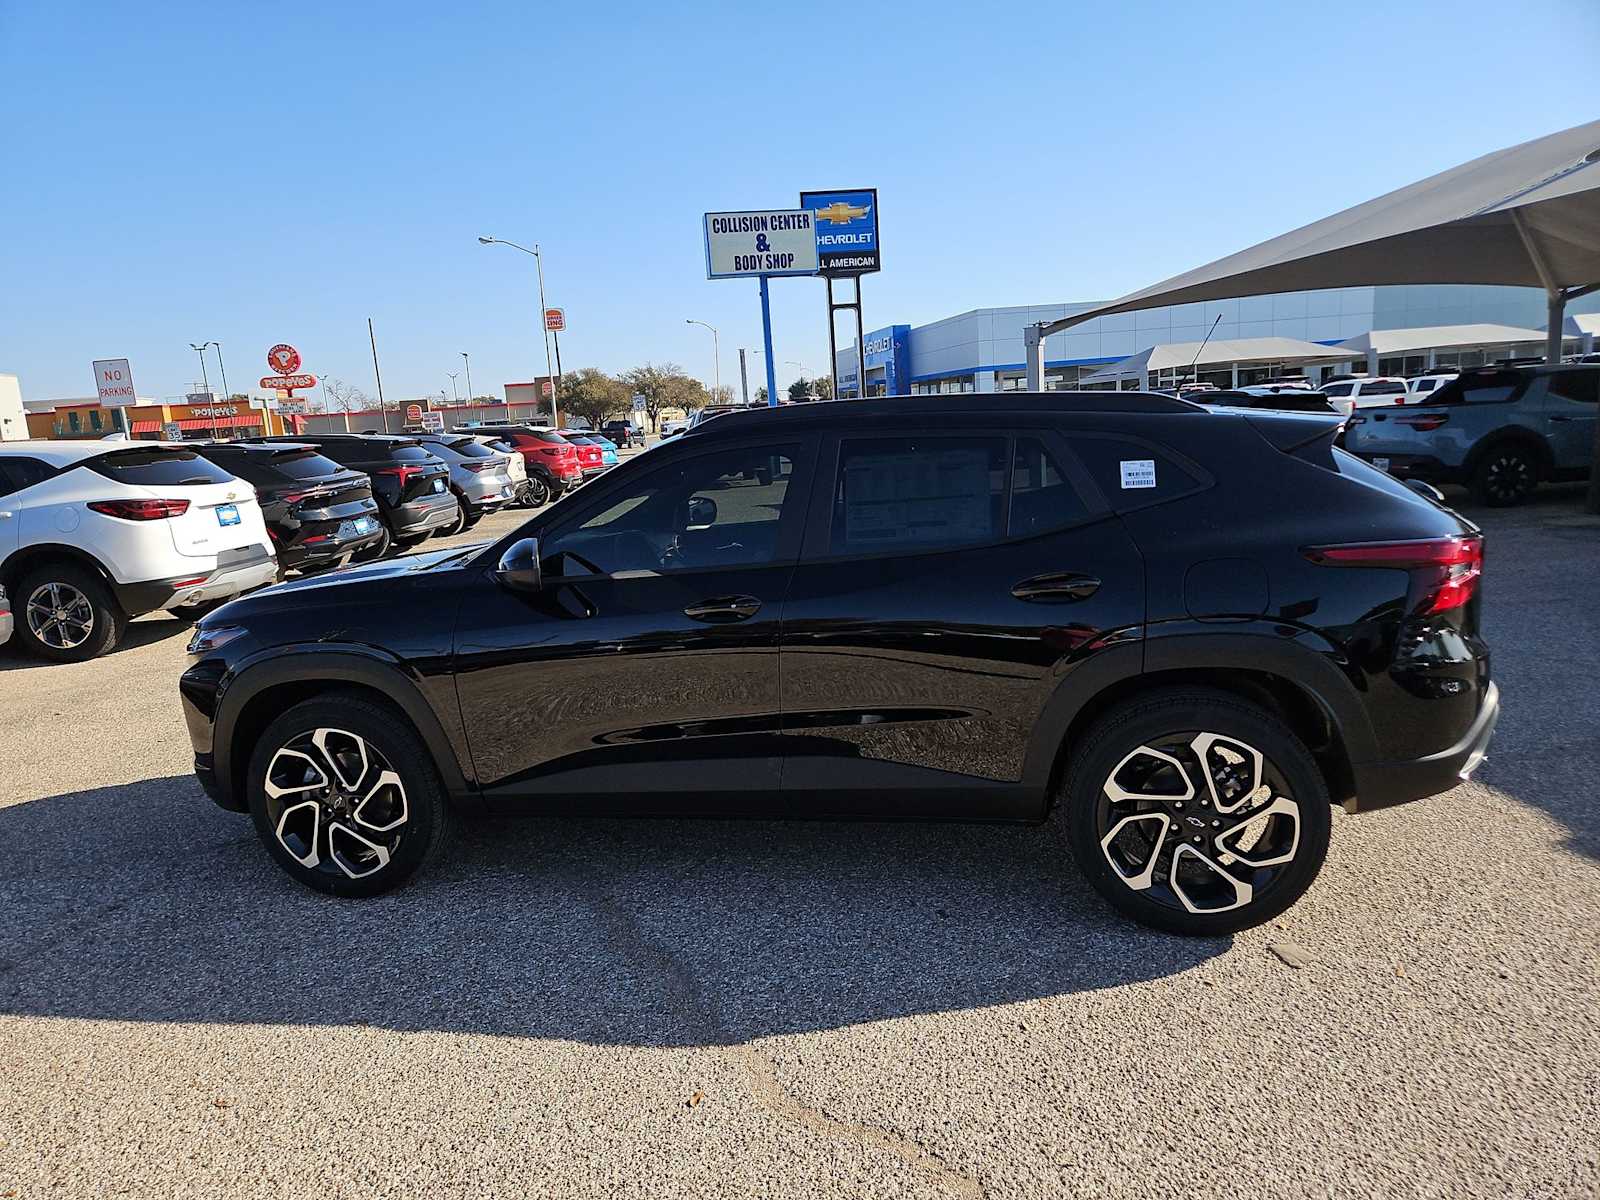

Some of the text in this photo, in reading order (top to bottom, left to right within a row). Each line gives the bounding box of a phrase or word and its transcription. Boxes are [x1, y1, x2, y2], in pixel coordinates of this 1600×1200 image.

[712, 213, 810, 234] COLLISION CENTER
[755, 233, 771, 253] &
[817, 233, 873, 246] HEVROLET
[734, 252, 794, 271] BODY SHOP
[829, 256, 875, 269] AMERICAN
[104, 370, 122, 381] NO
[99, 386, 133, 397] PARKING
